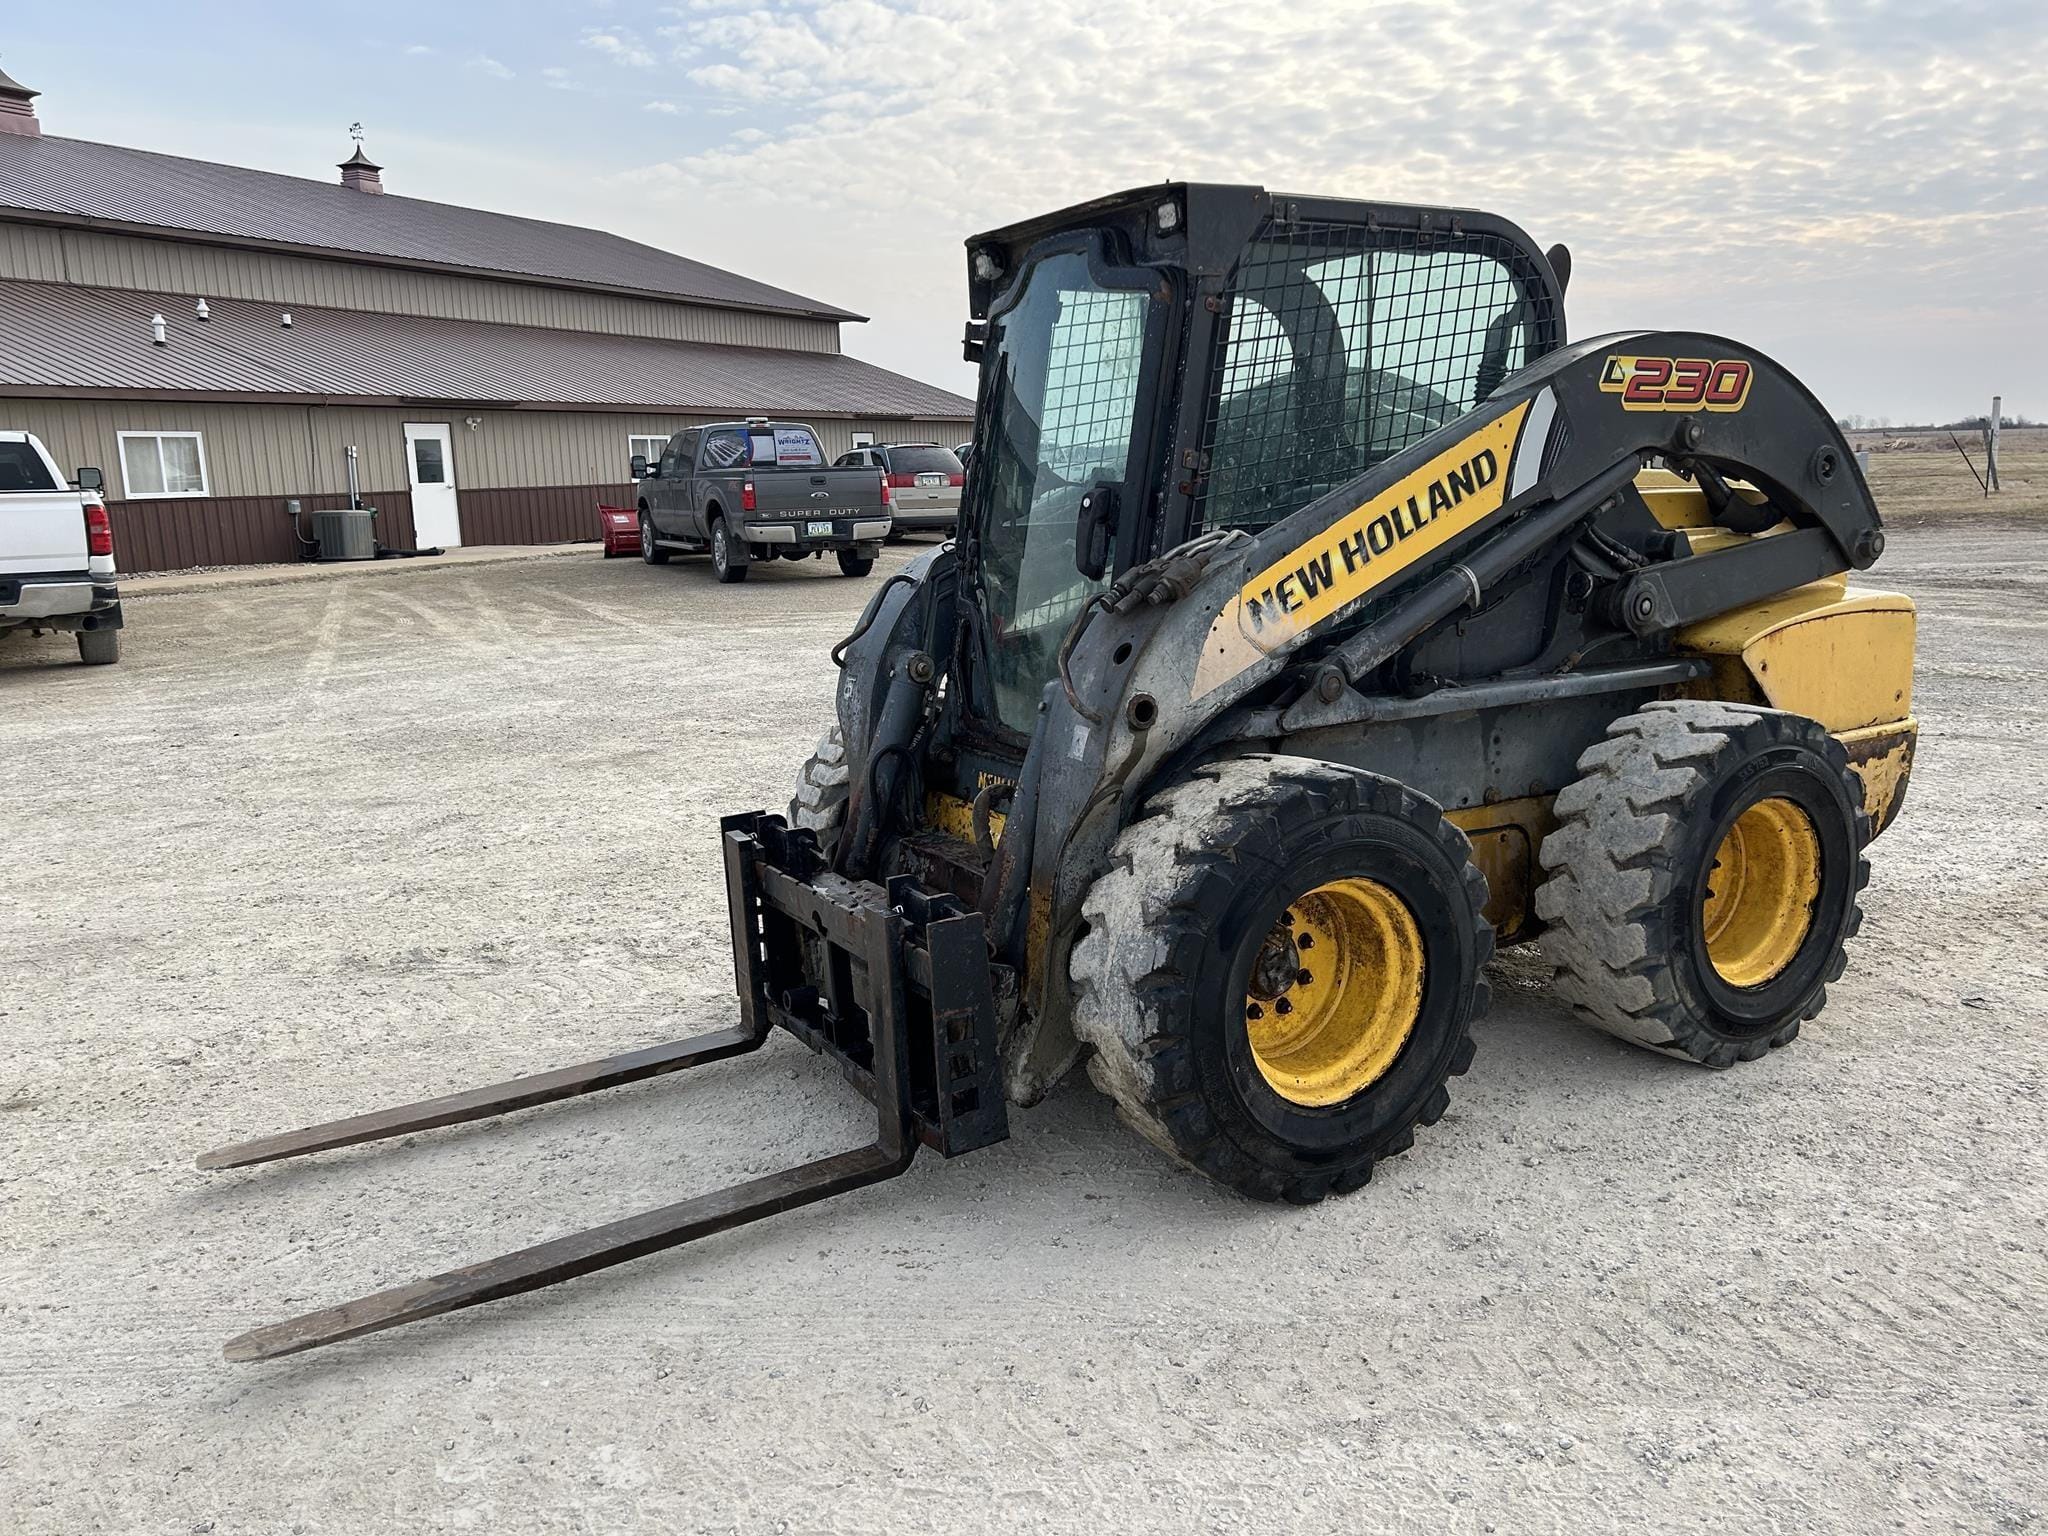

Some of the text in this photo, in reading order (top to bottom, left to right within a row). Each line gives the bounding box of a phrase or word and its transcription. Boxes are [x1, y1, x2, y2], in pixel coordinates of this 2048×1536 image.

[779, 509, 821, 517] SUPER
[1246, 448, 1498, 634] NEW HOLLAND
